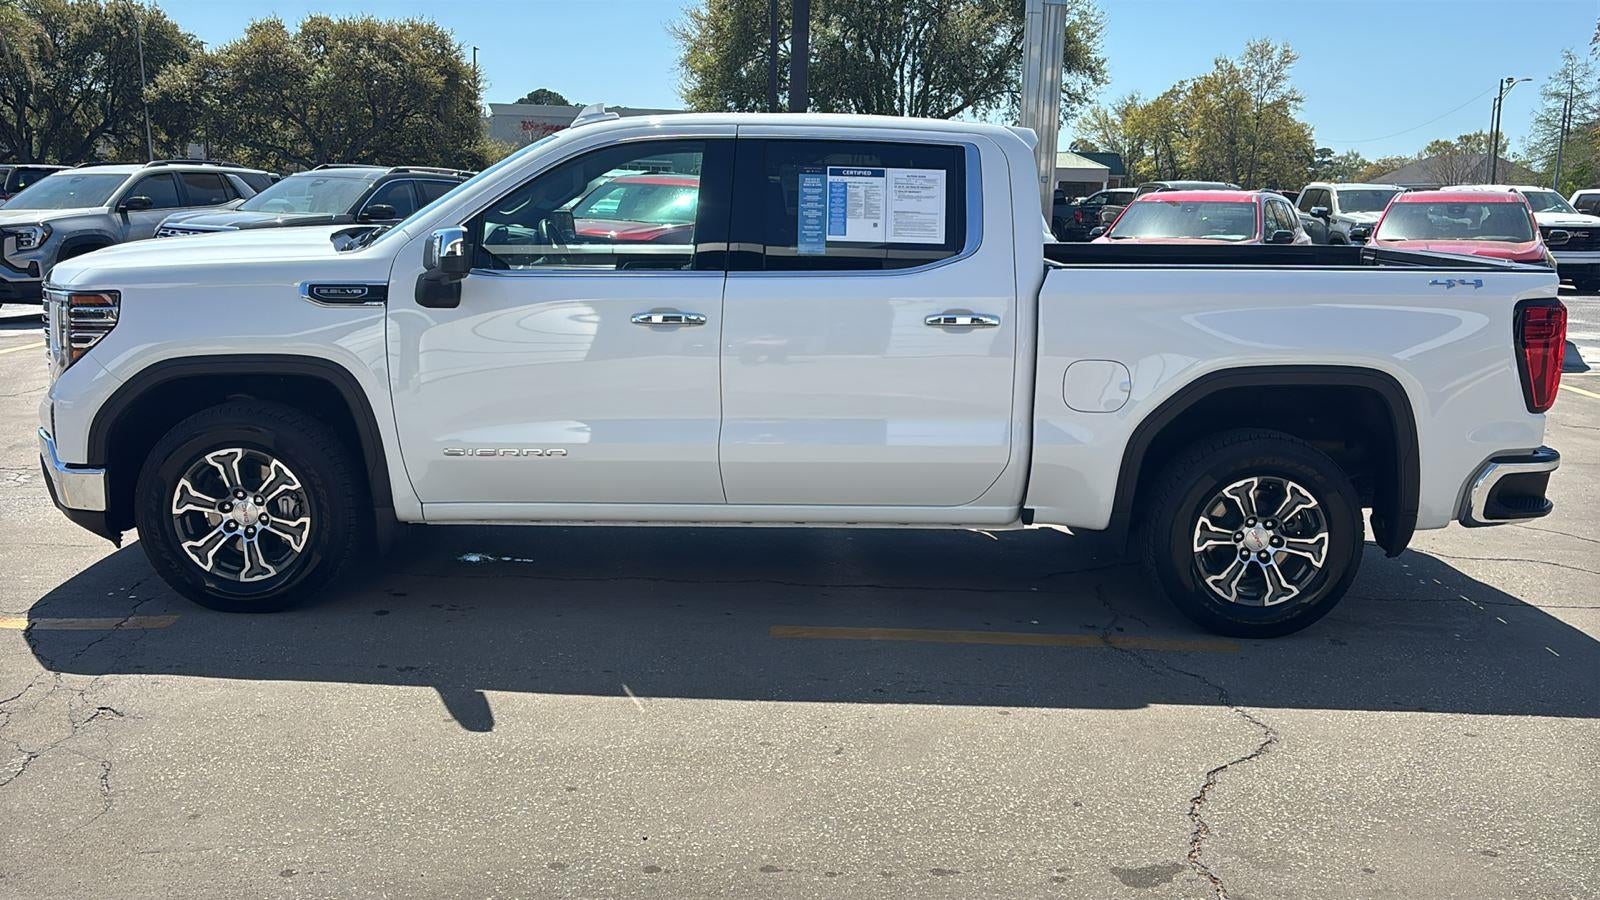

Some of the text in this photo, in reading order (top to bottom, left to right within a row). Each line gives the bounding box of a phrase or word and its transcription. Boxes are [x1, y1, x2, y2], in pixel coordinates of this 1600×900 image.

[442, 447, 568, 457] SIERRA
[241, 503, 250, 523] GMC
[1251, 530, 1263, 548] GMC
